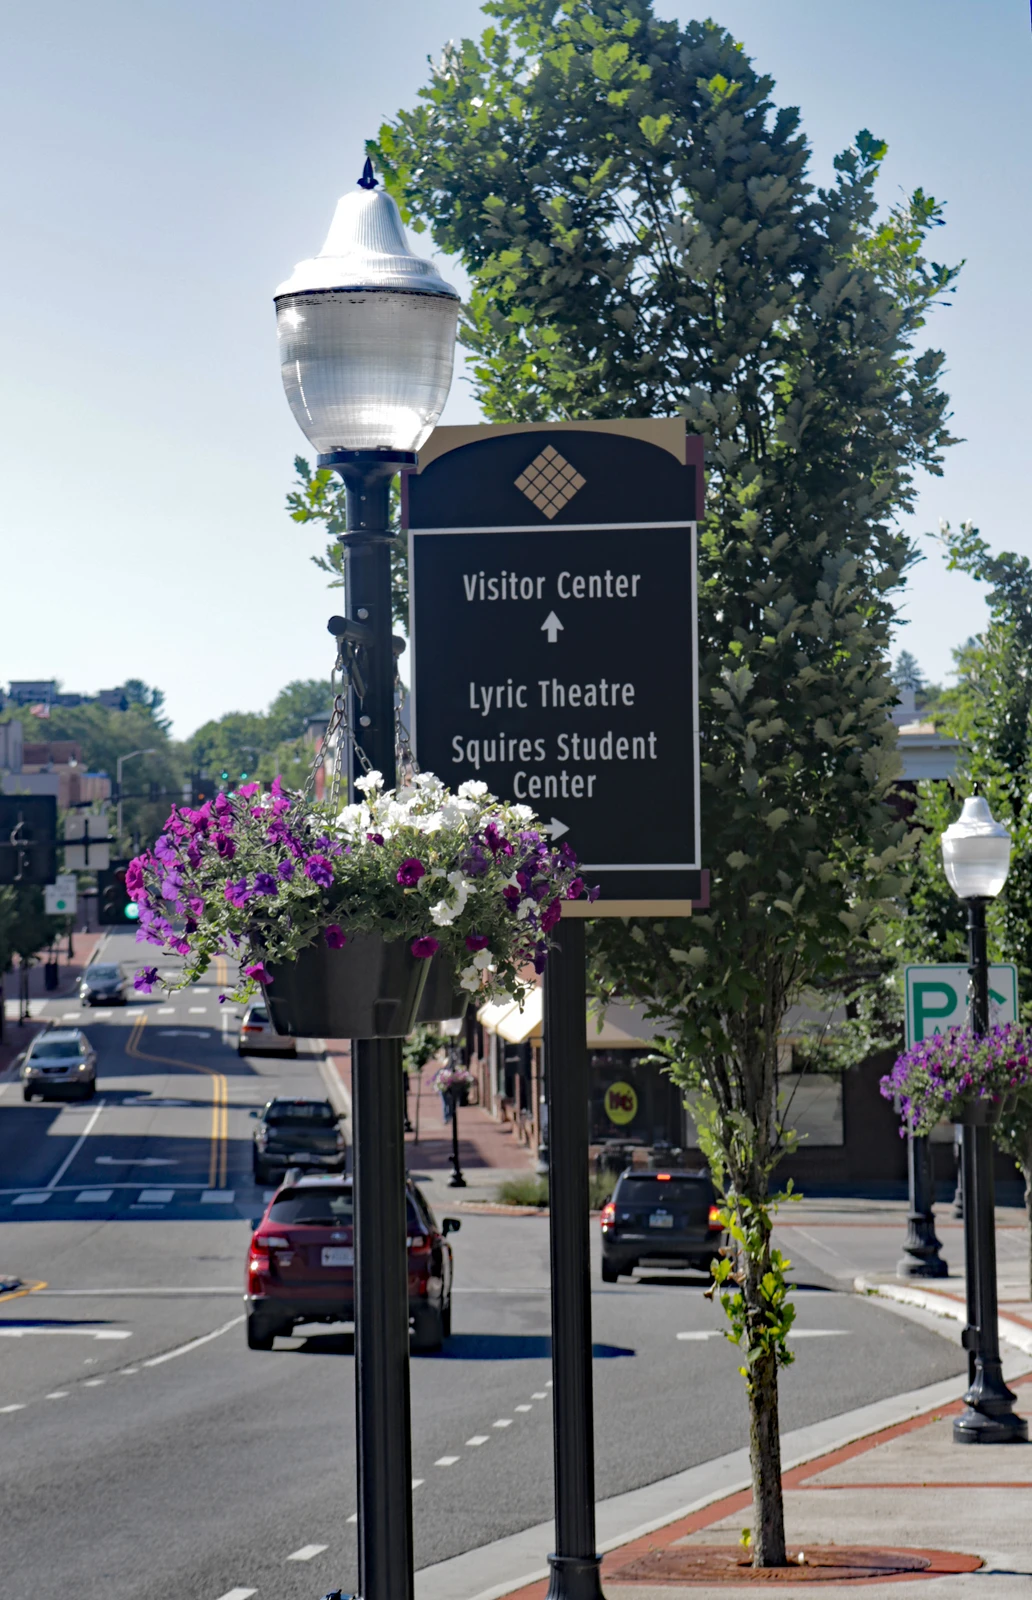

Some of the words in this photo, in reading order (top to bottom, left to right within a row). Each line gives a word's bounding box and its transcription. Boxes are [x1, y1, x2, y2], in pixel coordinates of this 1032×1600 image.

[463, 570, 546, 601] Visitor
[557, 570, 641, 600] Center
[469, 679, 528, 716] Lyric
[538, 679, 635, 707] Theatre
[452, 732, 546, 770] Squires
[557, 731, 658, 761] Student
[513, 770, 597, 799] Center
